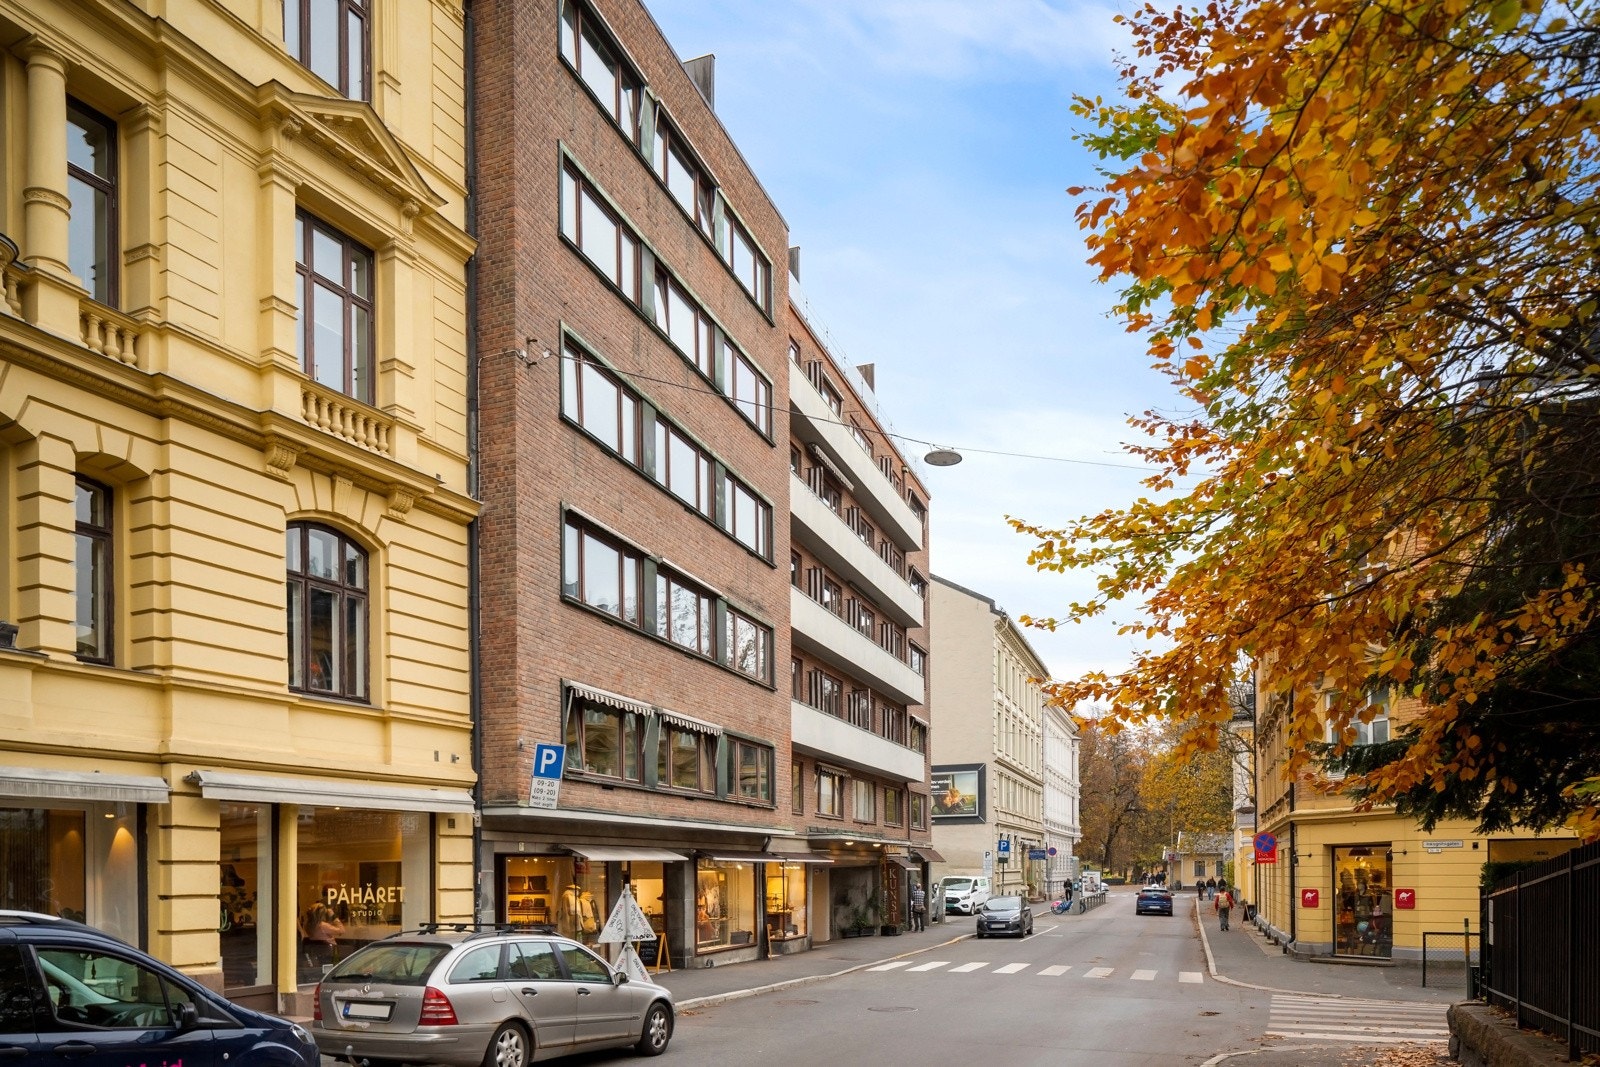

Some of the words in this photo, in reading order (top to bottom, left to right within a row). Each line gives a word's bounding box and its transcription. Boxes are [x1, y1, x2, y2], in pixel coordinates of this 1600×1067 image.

[540, 748, 557, 774] P
[1000, 841, 1008, 851] P
[985, 851, 991, 859] P
[889, 868, 898, 922] KUNST
[352, 909, 383, 918] STUDIO
